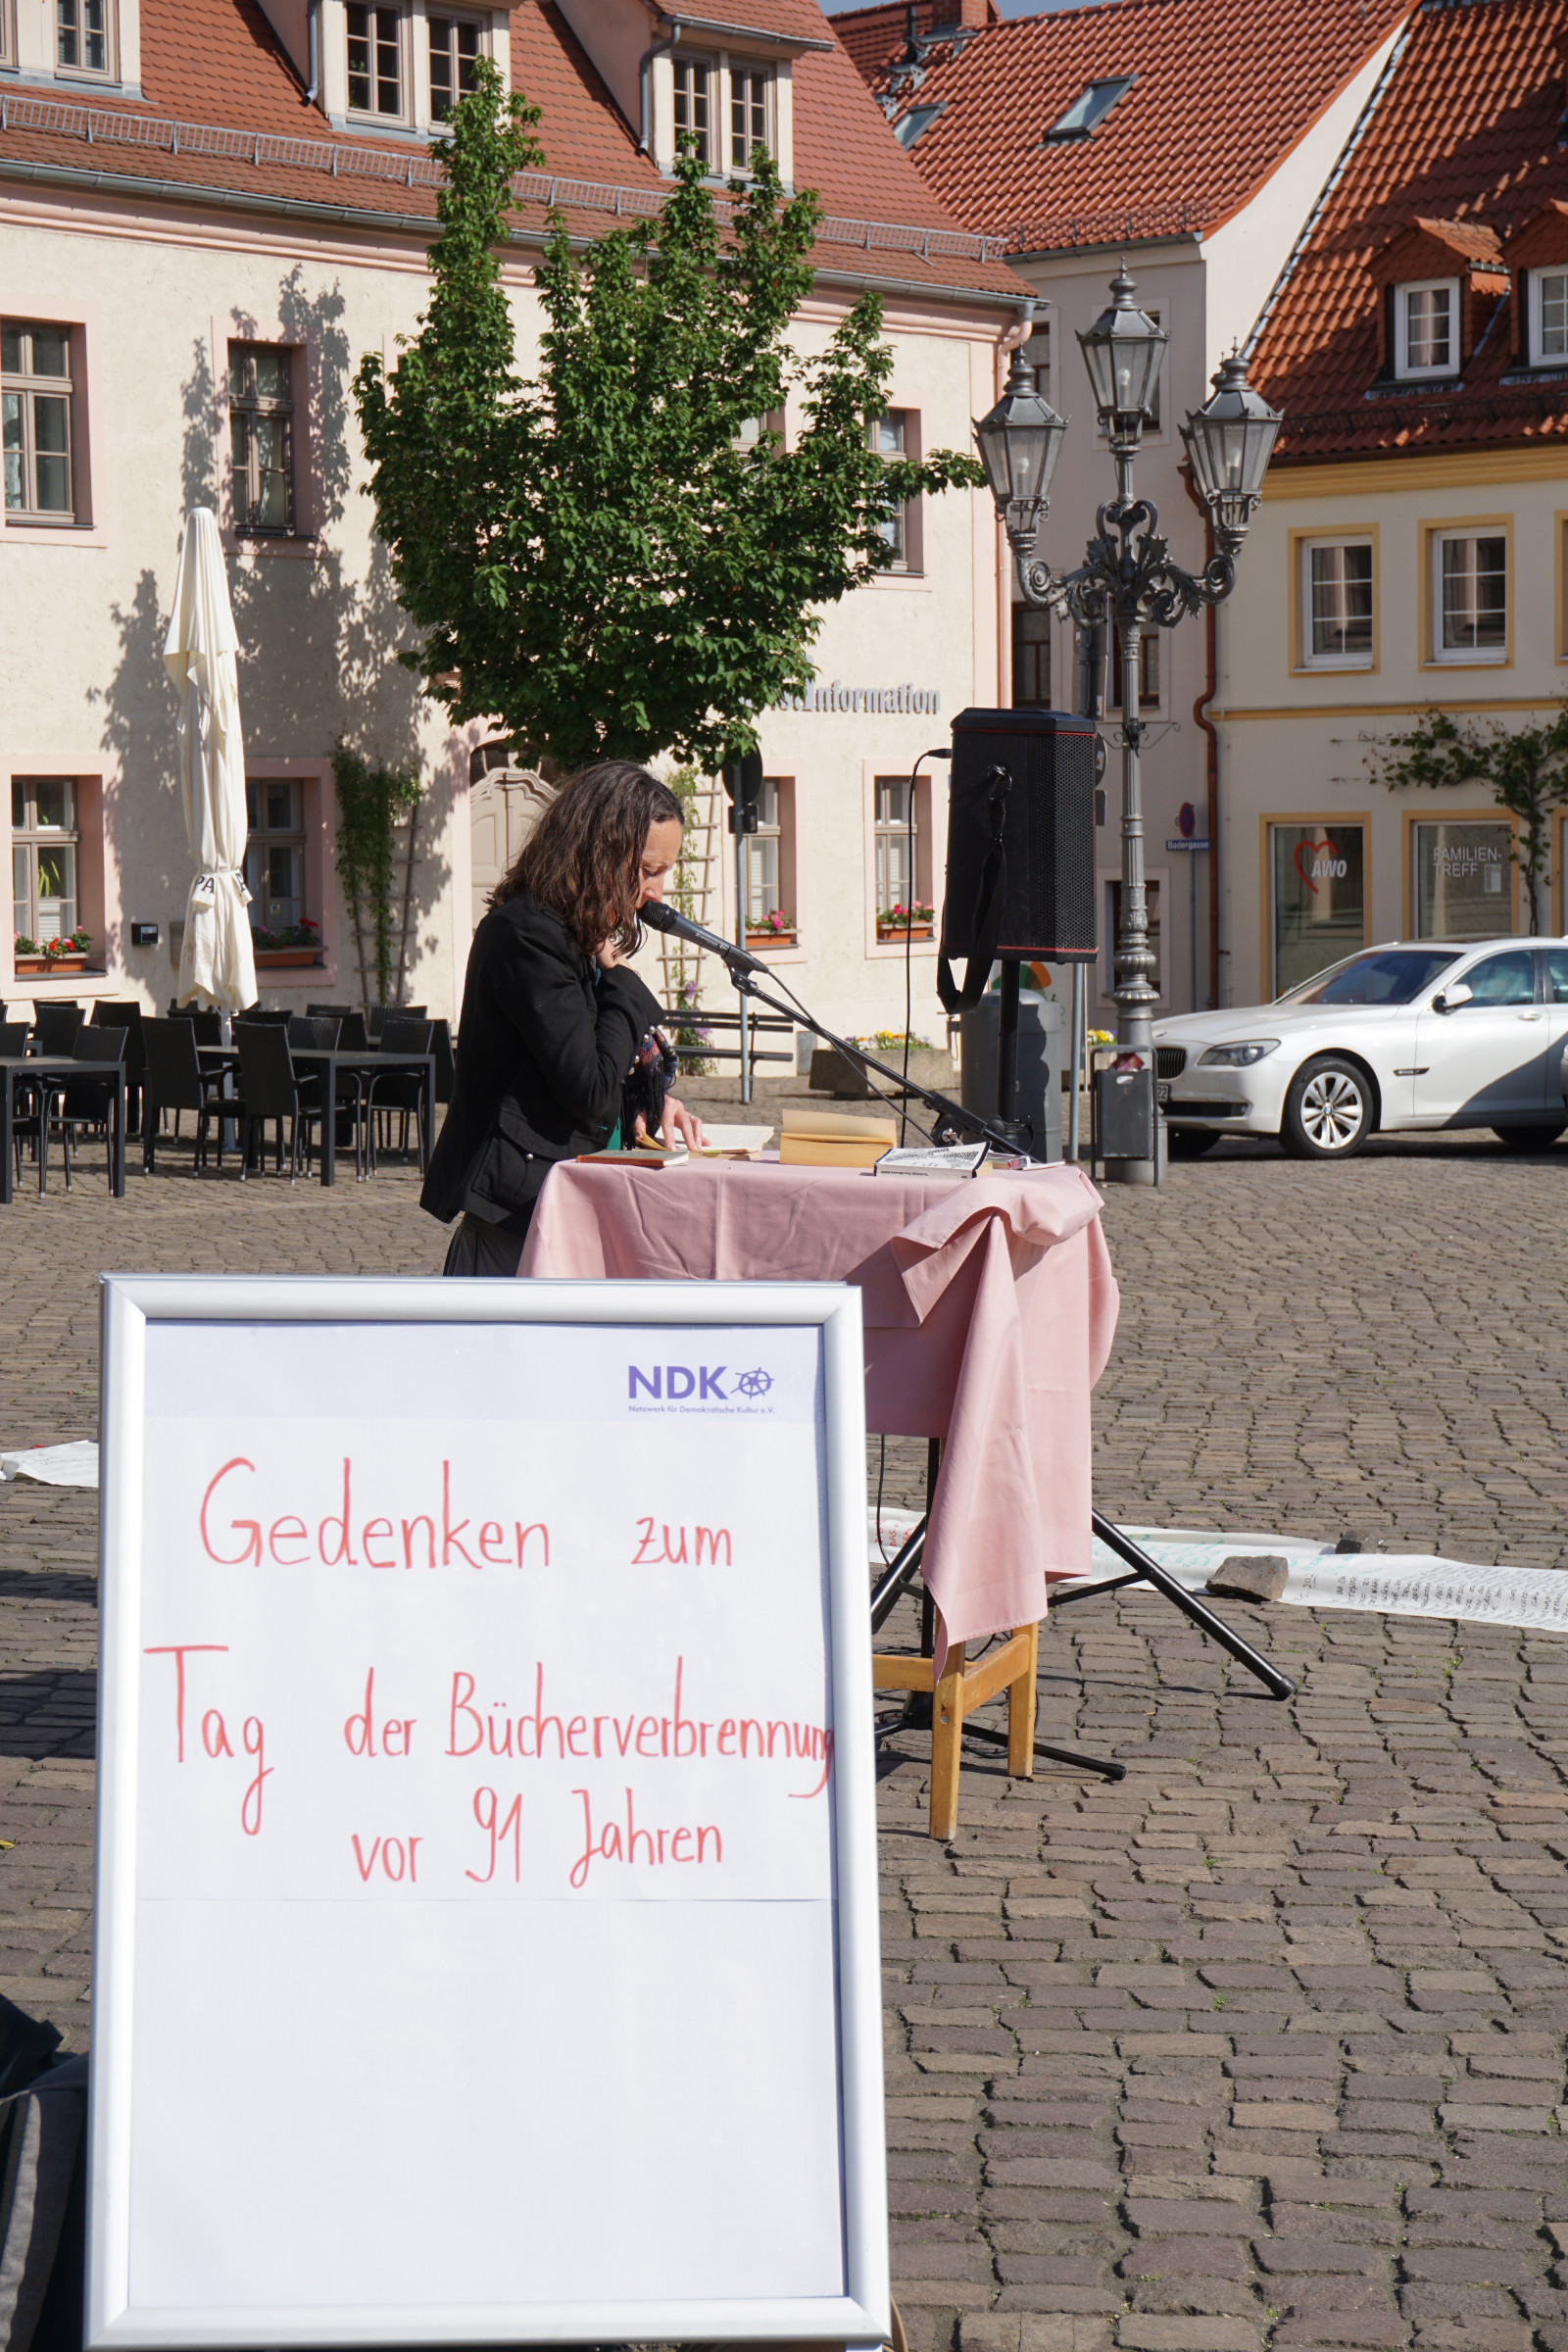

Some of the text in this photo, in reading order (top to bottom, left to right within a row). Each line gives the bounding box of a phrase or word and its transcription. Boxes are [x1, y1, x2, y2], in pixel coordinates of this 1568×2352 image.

[803, 679, 941, 715] Information
[1167, 841, 1209, 851] Badergasse
[1434, 847, 1502, 861] FAMILIEN-
[1311, 859, 1348, 878] AWO
[1434, 862, 1478, 877] TREFF
[628, 1365, 729, 1400] NDK
[628, 1404, 665, 1413] Netzwerk
[666, 1404, 678, 1413] für
[679, 1405, 735, 1414] Demokratische
[200, 1457, 732, 1569] Gedenken zum
[144, 1645, 833, 1835] Tag der Bücherverbrennung
[352, 1787, 722, 1888] vor 91 Jahren
